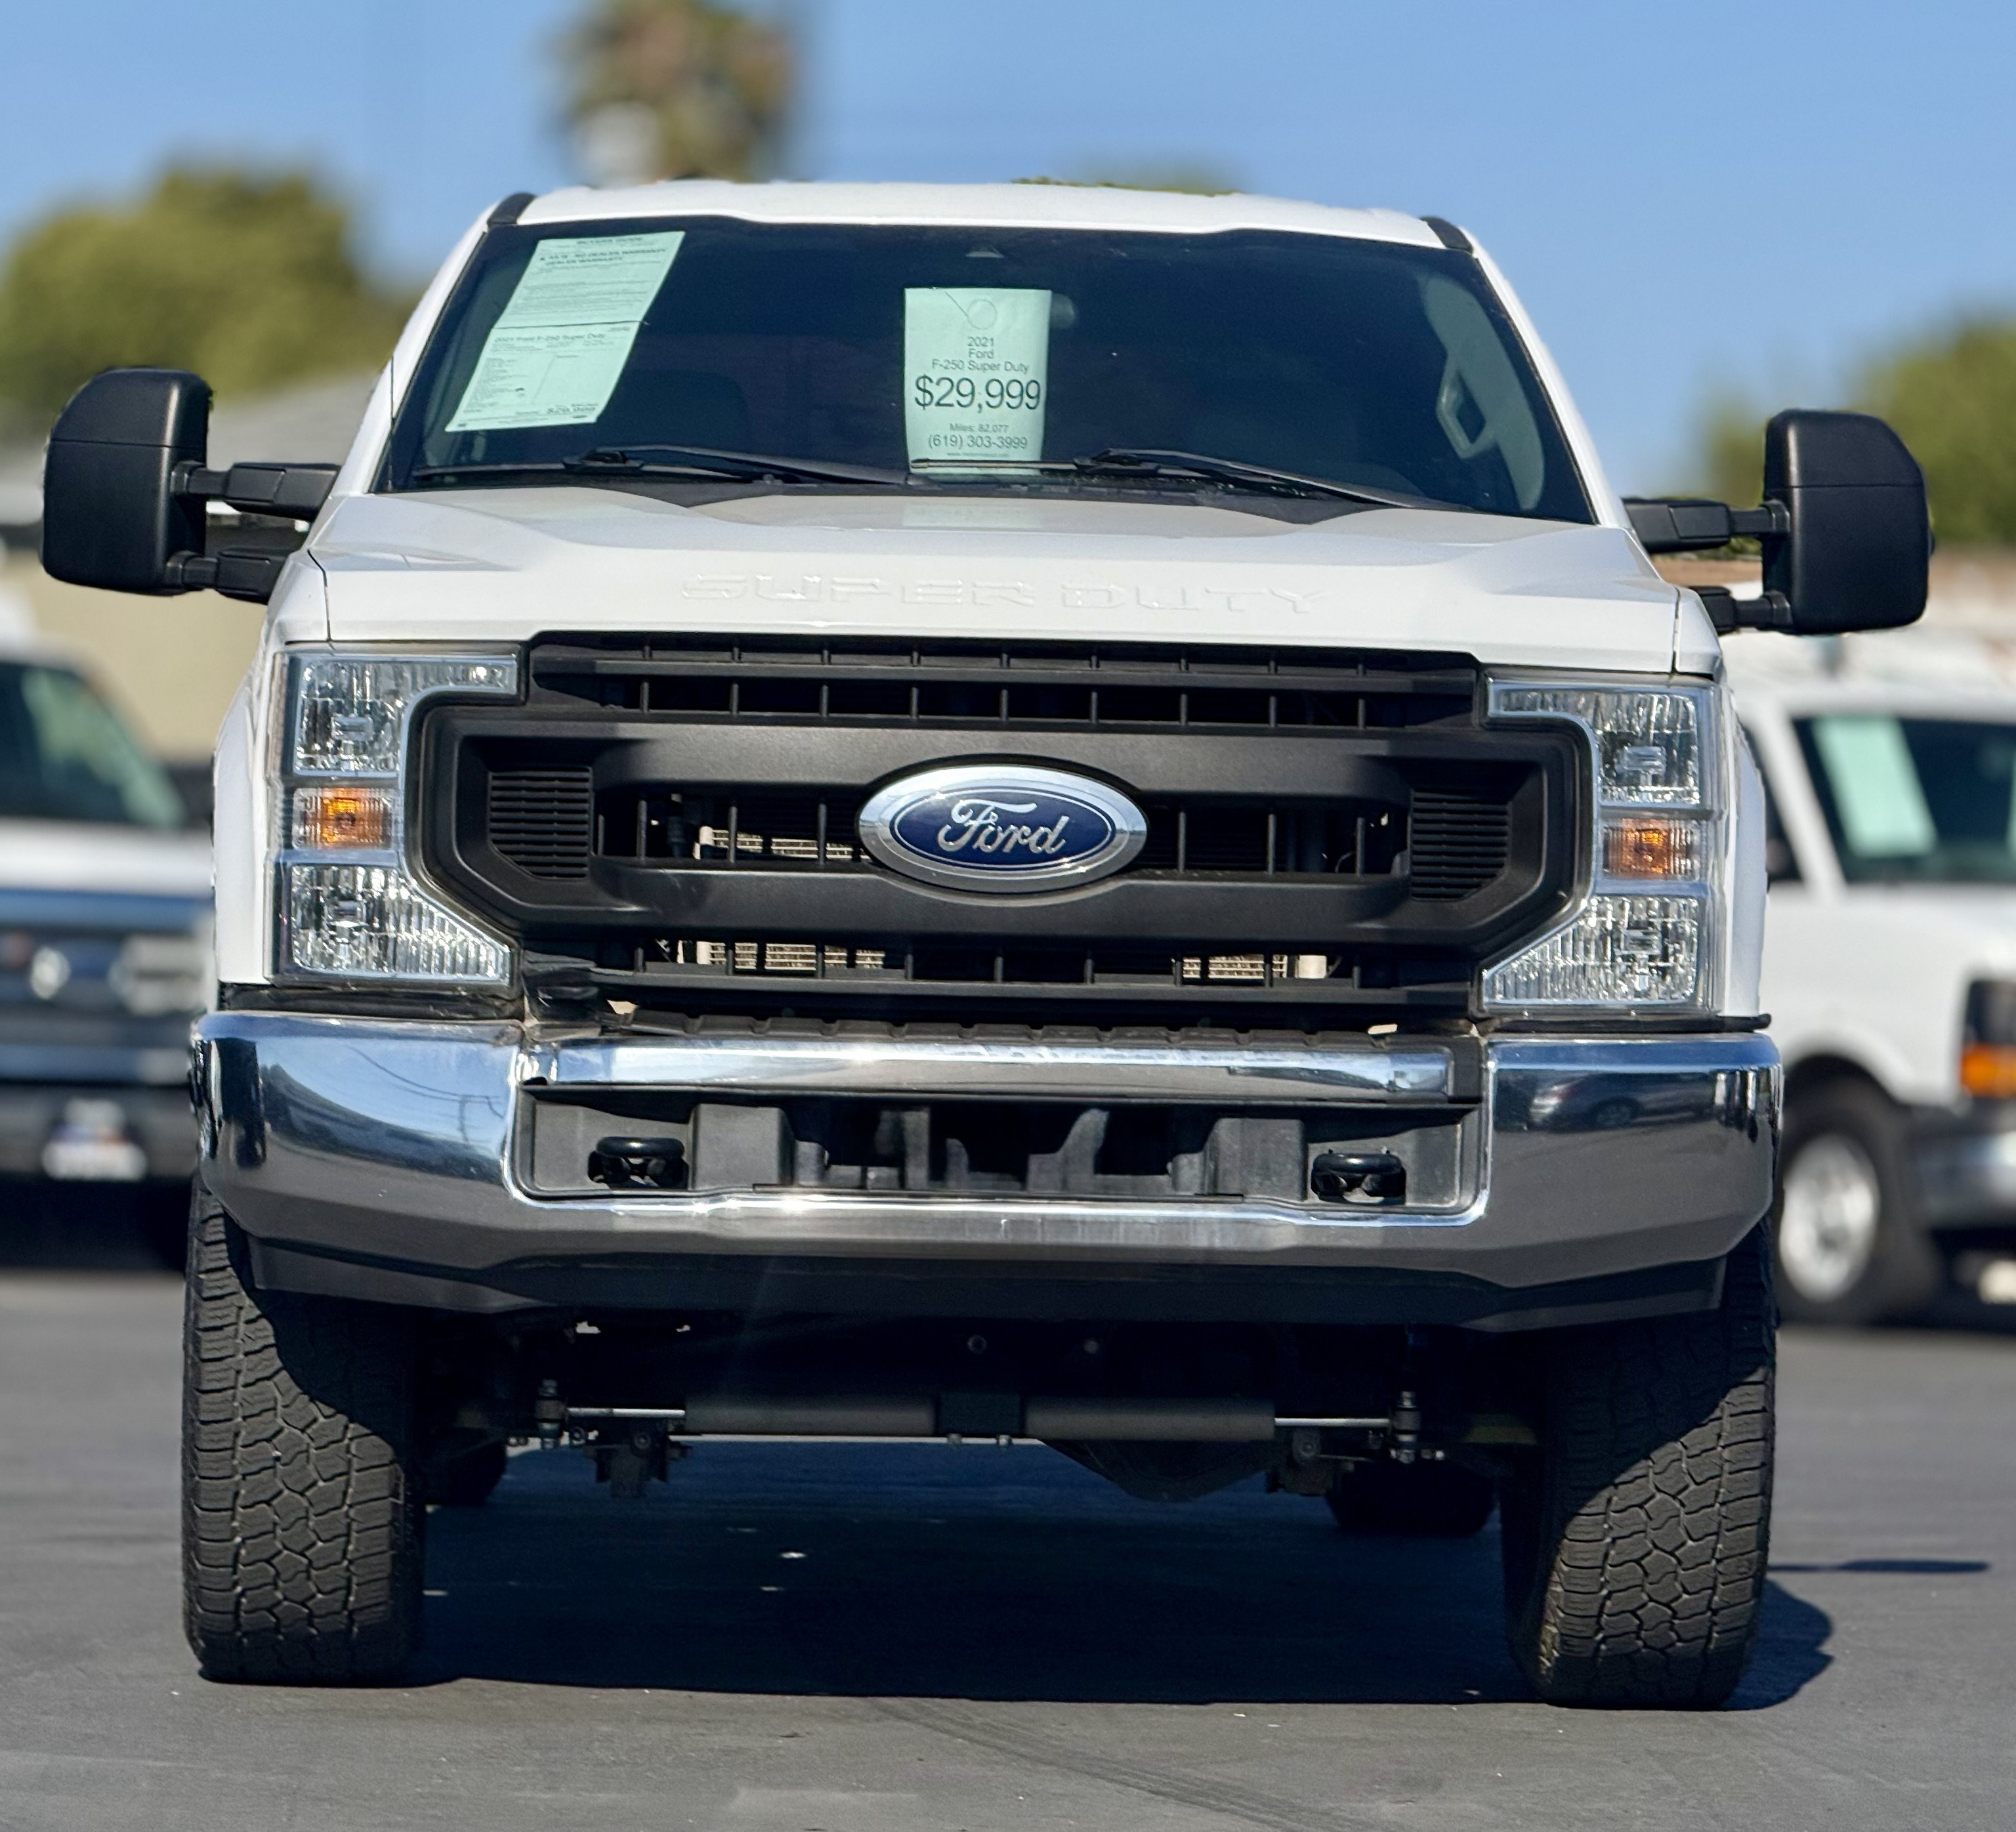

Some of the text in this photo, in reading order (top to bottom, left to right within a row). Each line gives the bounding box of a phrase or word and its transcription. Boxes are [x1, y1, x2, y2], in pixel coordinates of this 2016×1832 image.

[967, 336, 995, 347] 2021
[968, 349, 994, 359] Ford
[932, 358, 1029, 375] F-250 Super Duty
[914, 373, 1041, 414] $29,999
[928, 434, 1028, 450] (619) 303-3999
[682, 574, 1331, 614] SUPER DUTY
[938, 799, 1070, 854] Ford
